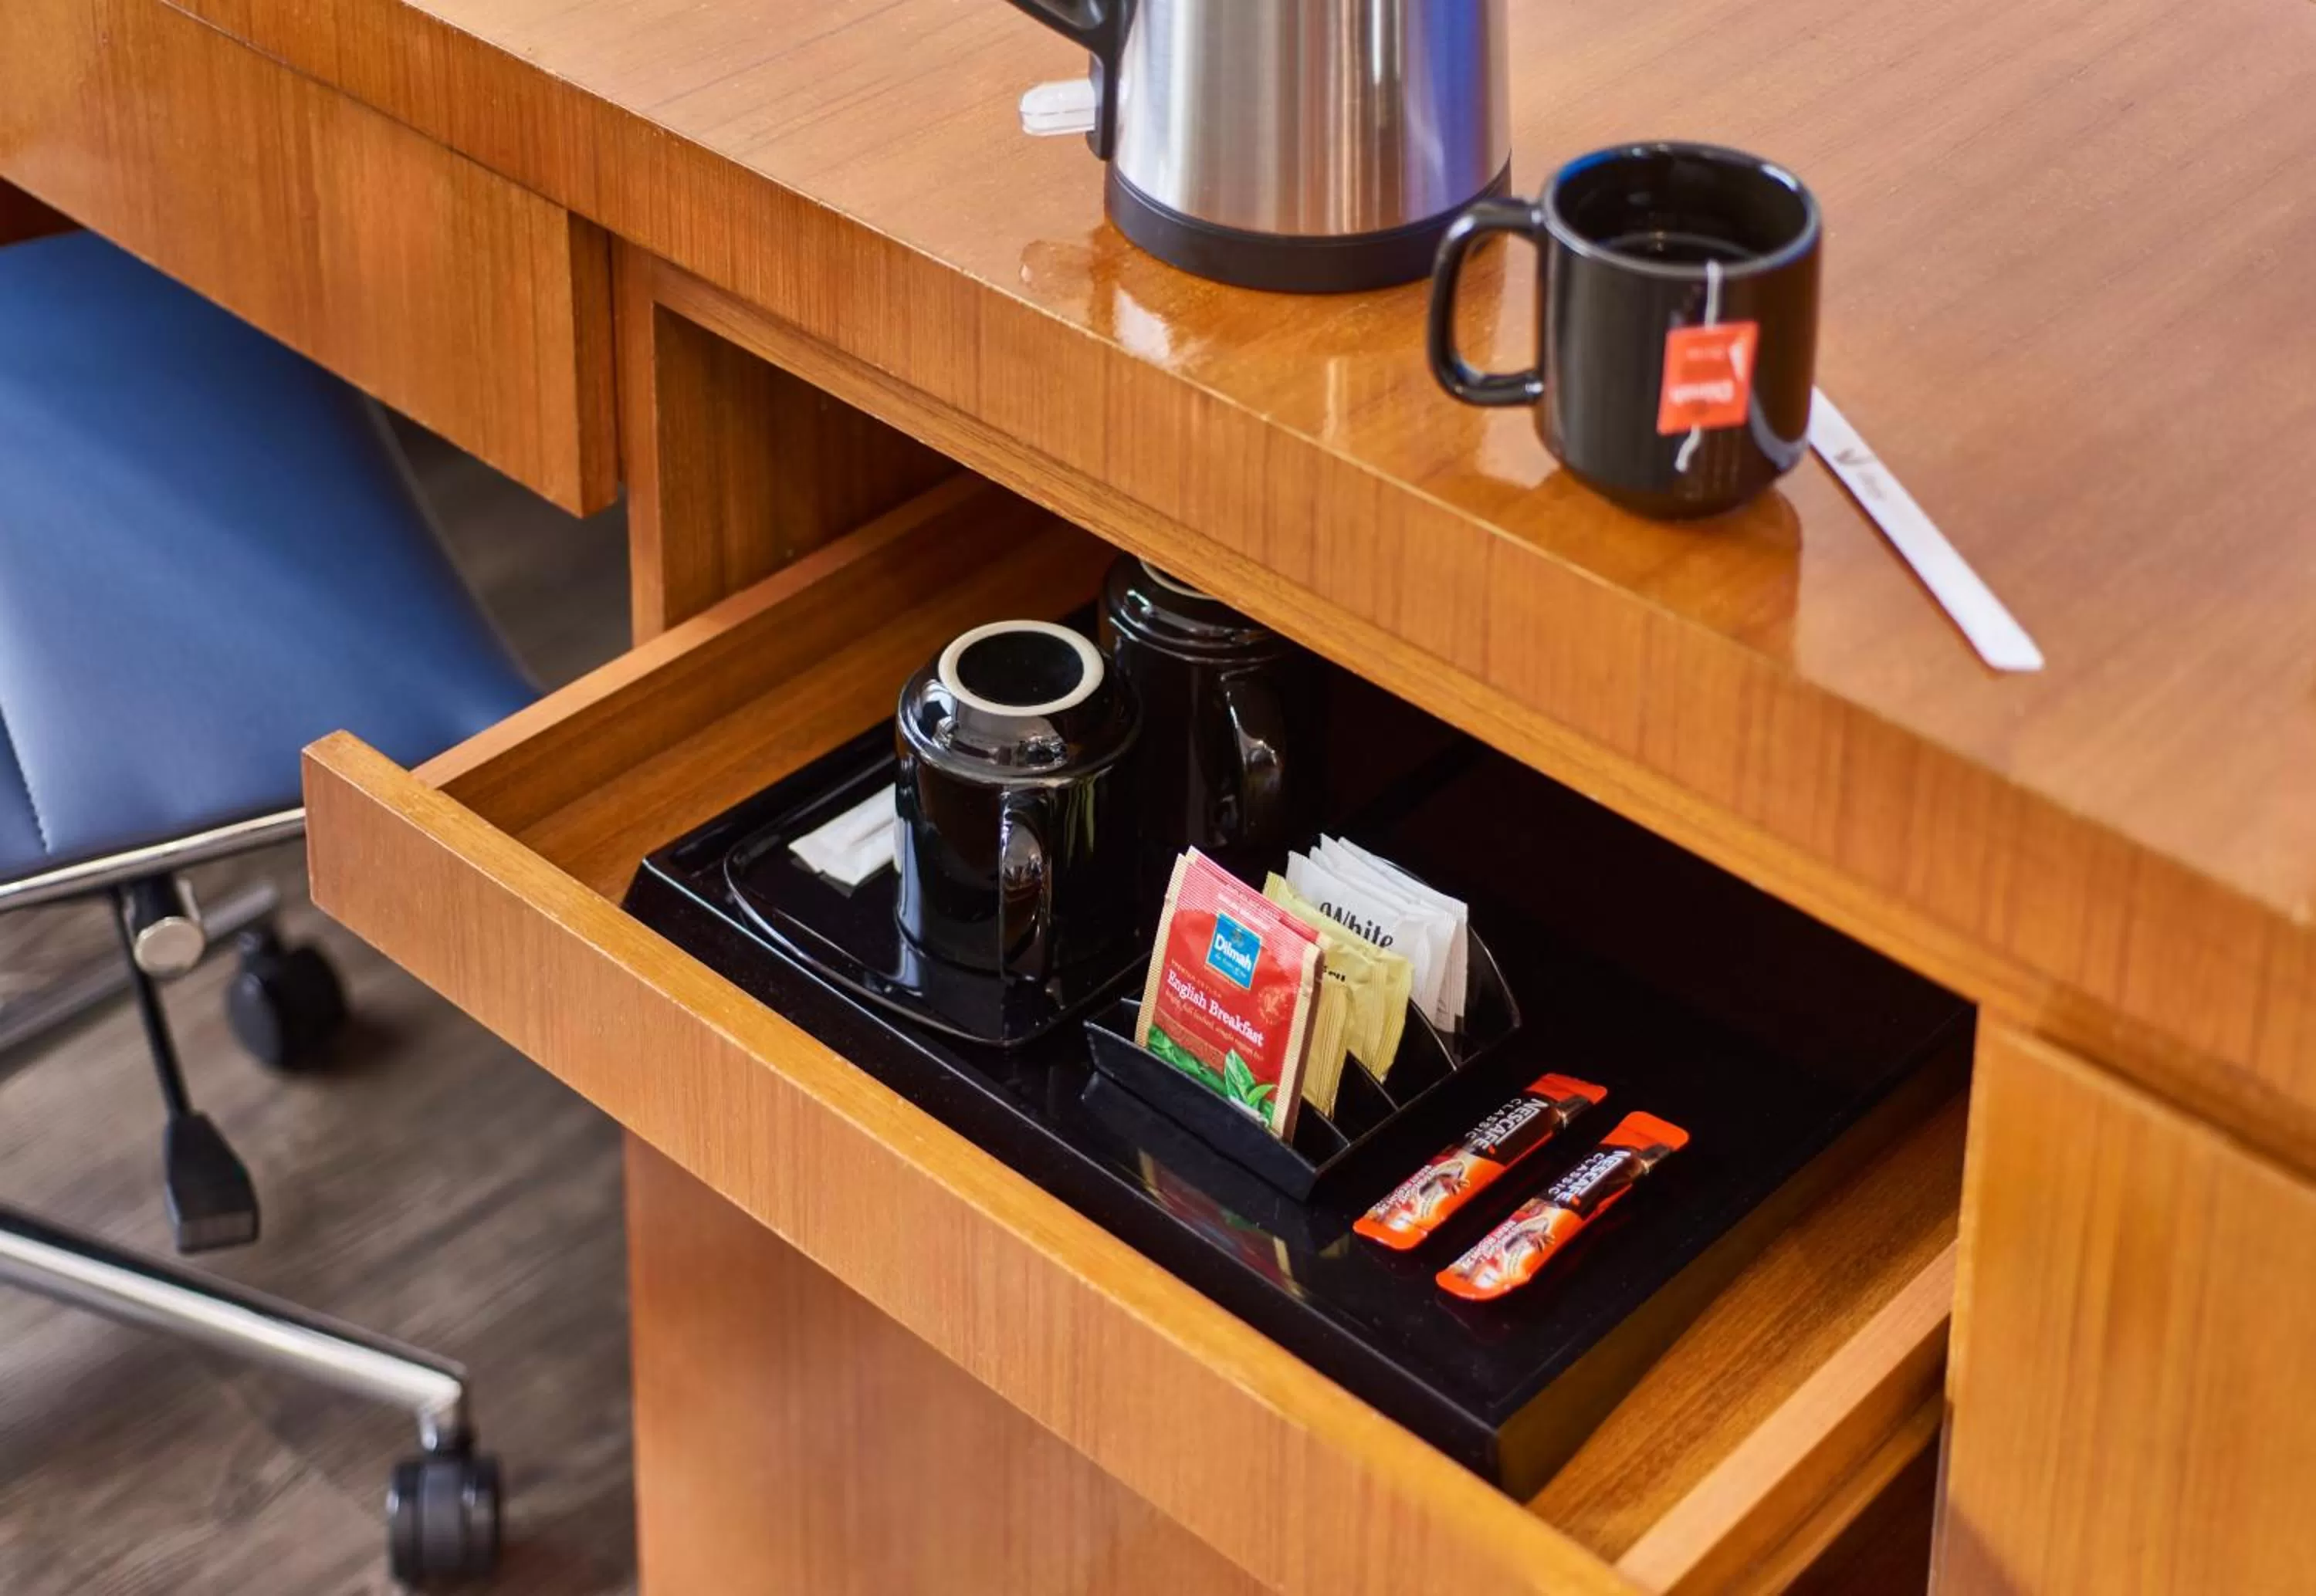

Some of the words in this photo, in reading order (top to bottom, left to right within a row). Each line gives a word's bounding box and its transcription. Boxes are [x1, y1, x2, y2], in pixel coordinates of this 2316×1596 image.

[1214, 933, 1252, 972] Dilmah
[1166, 968, 1207, 1009] English
[1208, 999, 1265, 1047] Breakfast
[1465, 1098, 1522, 1139] CLASSIC
[1548, 1152, 1605, 1195] CLASSIC
